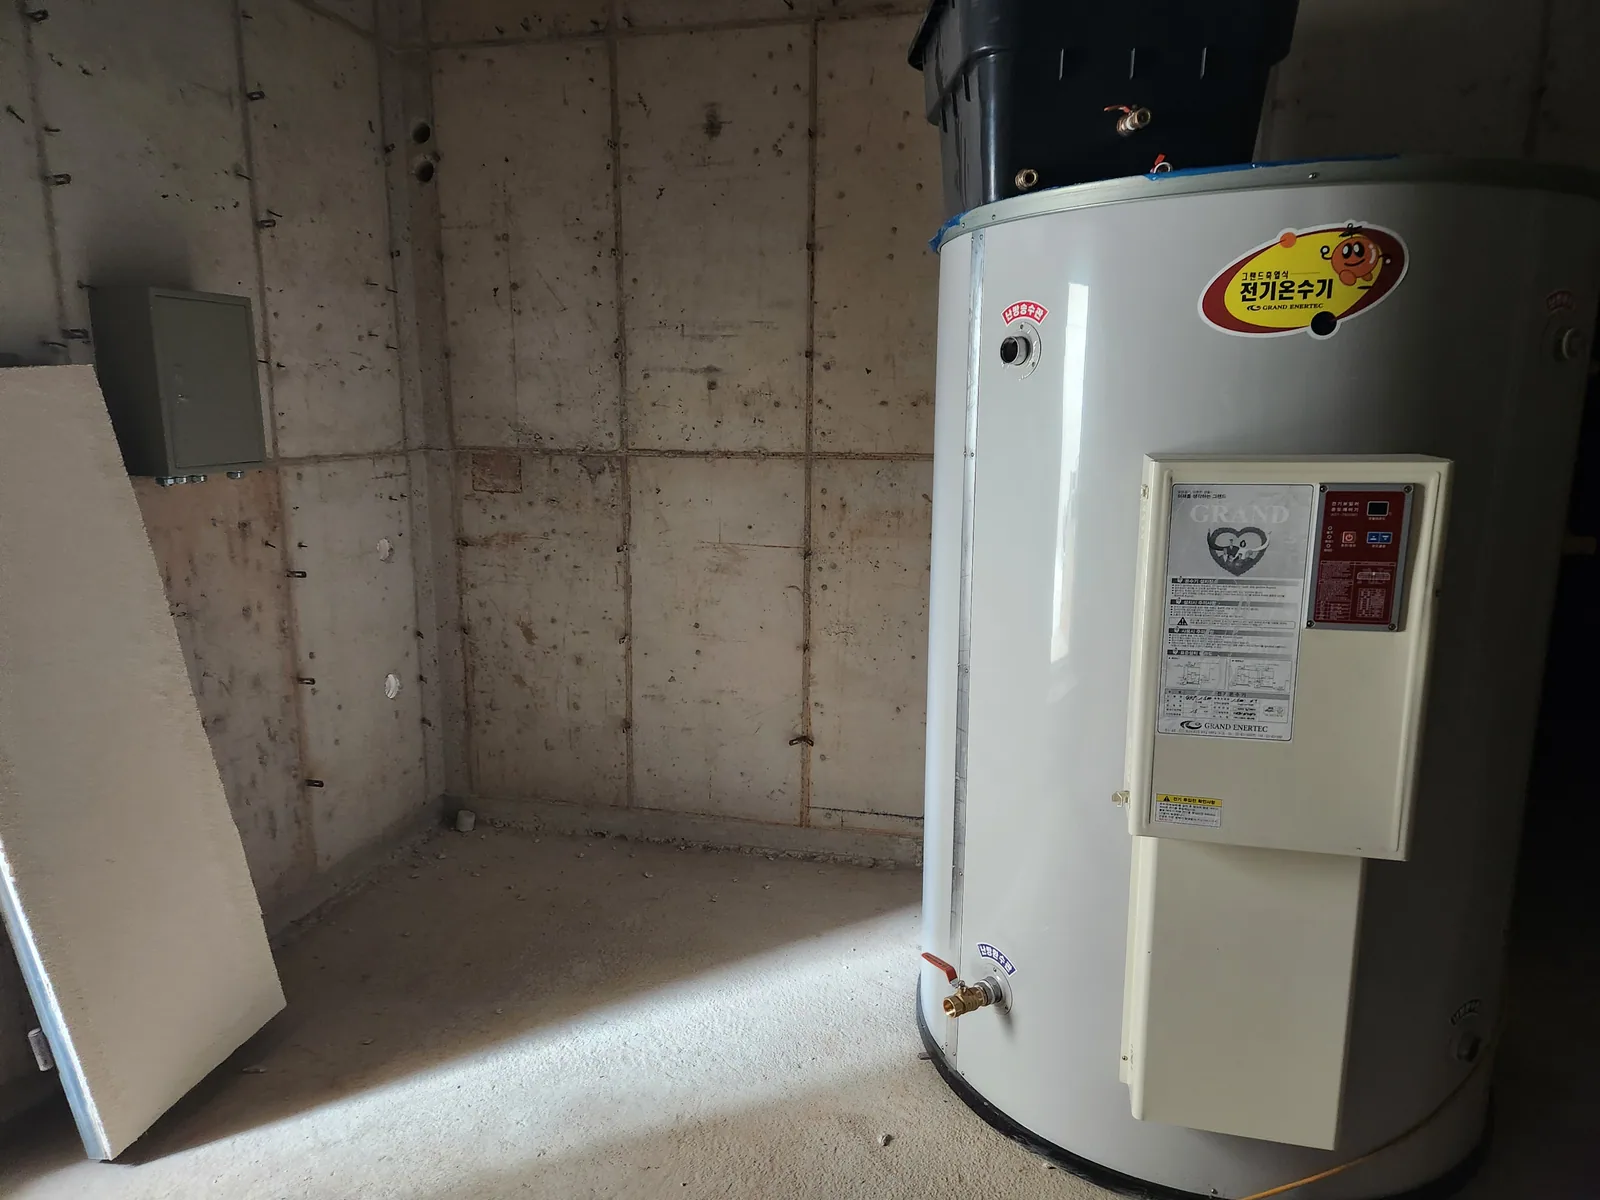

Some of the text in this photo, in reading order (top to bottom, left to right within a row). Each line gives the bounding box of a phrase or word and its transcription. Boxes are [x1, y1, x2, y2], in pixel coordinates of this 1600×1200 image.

[1240, 279, 1334, 302] 전기온수기
[1189, 503, 1290, 524] GRAND
[1204, 722, 1268, 733] GRAND ENERTEC
